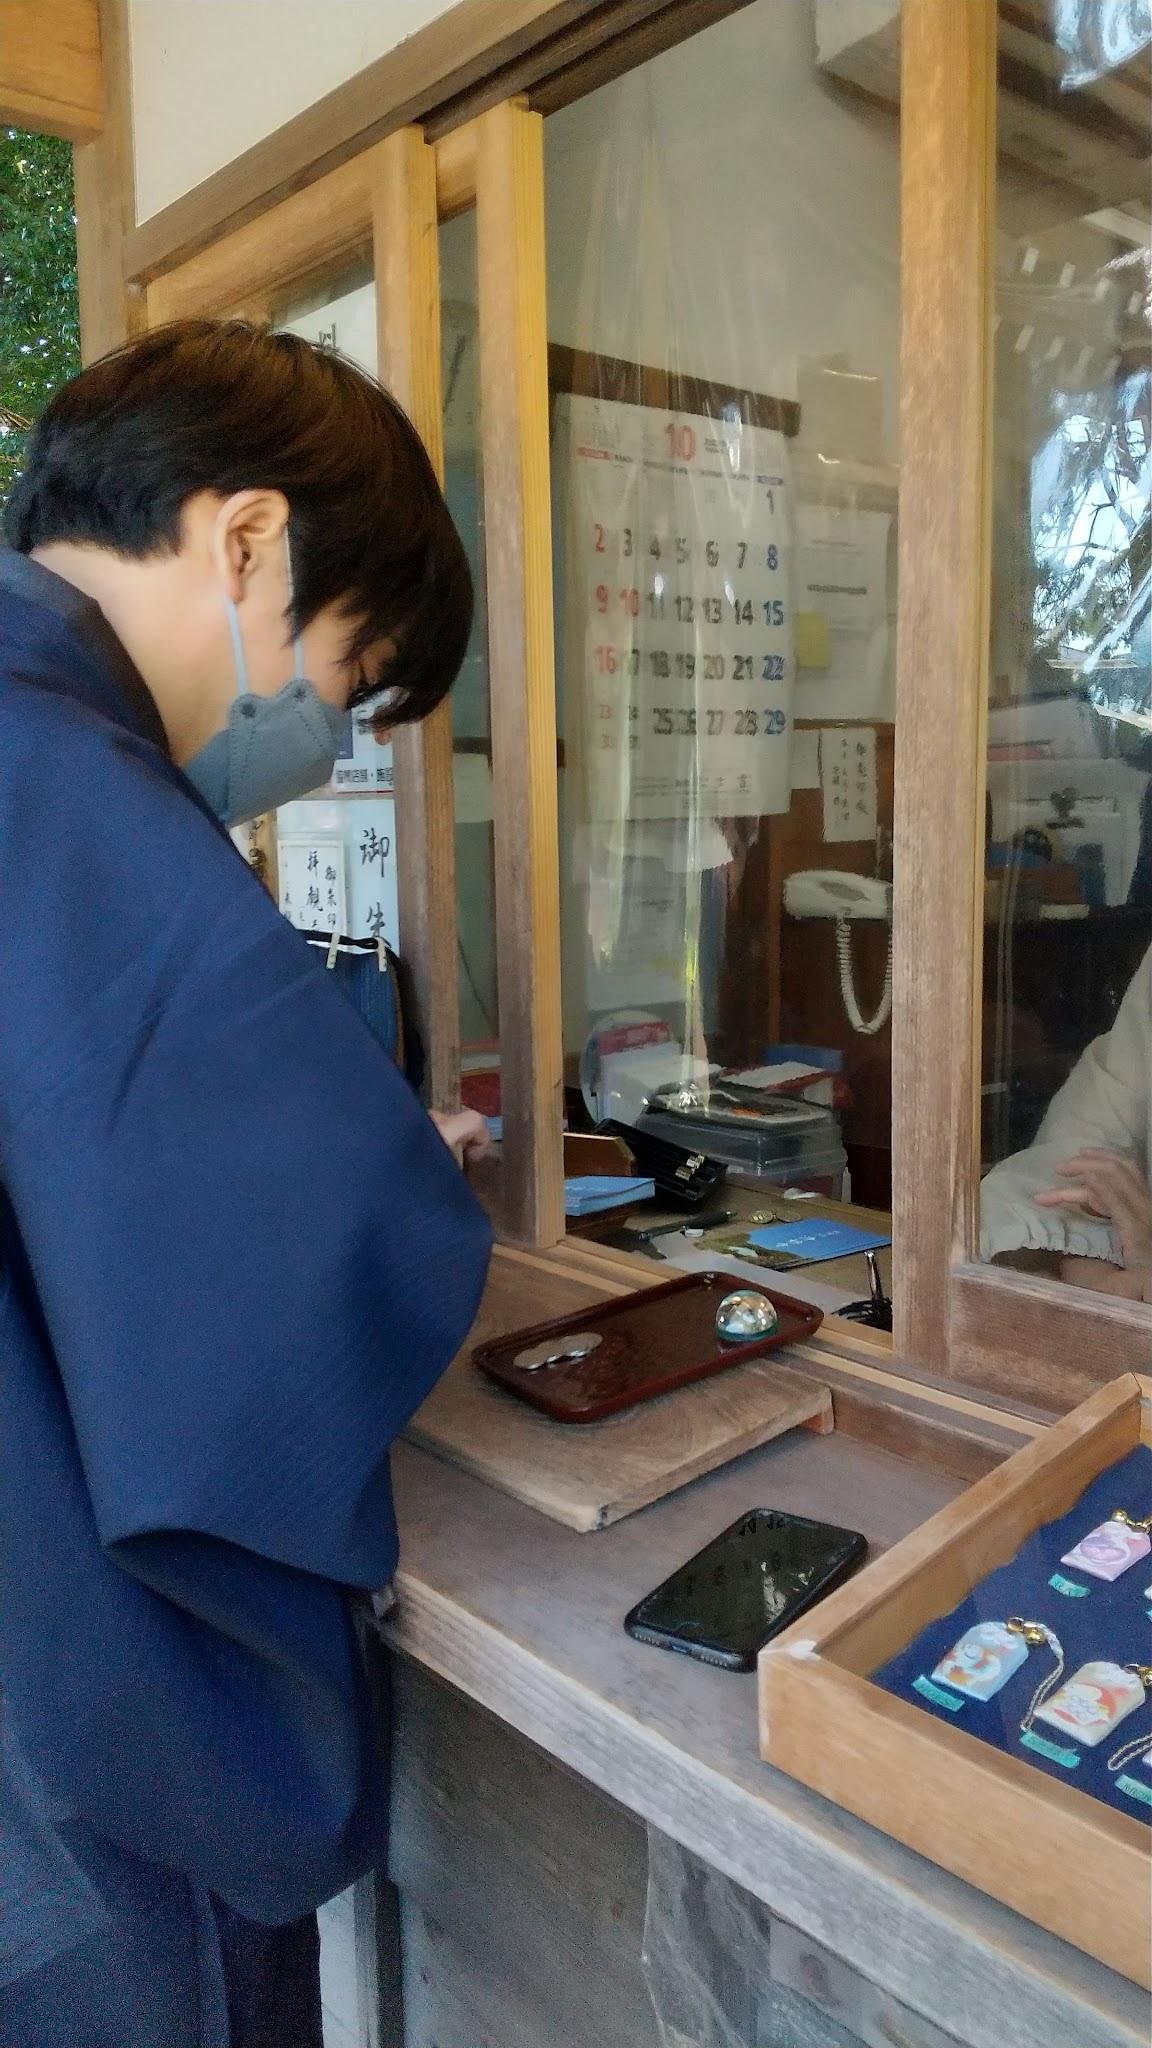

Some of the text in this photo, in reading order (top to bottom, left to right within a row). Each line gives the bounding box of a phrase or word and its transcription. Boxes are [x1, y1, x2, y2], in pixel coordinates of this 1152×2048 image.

[663, 423, 696, 462] 10
[766, 489, 774, 515] 1
[594, 523, 779, 571] 2 3 4 5 6 7 8
[595, 585, 784, 627] 9 10 11 12 13 14 15
[597, 645, 617, 675] 16
[650, 651, 671, 679] 18
[675, 653, 695, 679] 19
[703, 655, 725, 680] 20
[732, 655, 754, 680] 21
[762, 655, 785, 681] 22
[652, 707, 673, 735] 25
[678, 708, 697, 735] 26
[706, 709, 724, 735] 27
[735, 708, 758, 736] 28
[764, 709, 786, 735] 29
